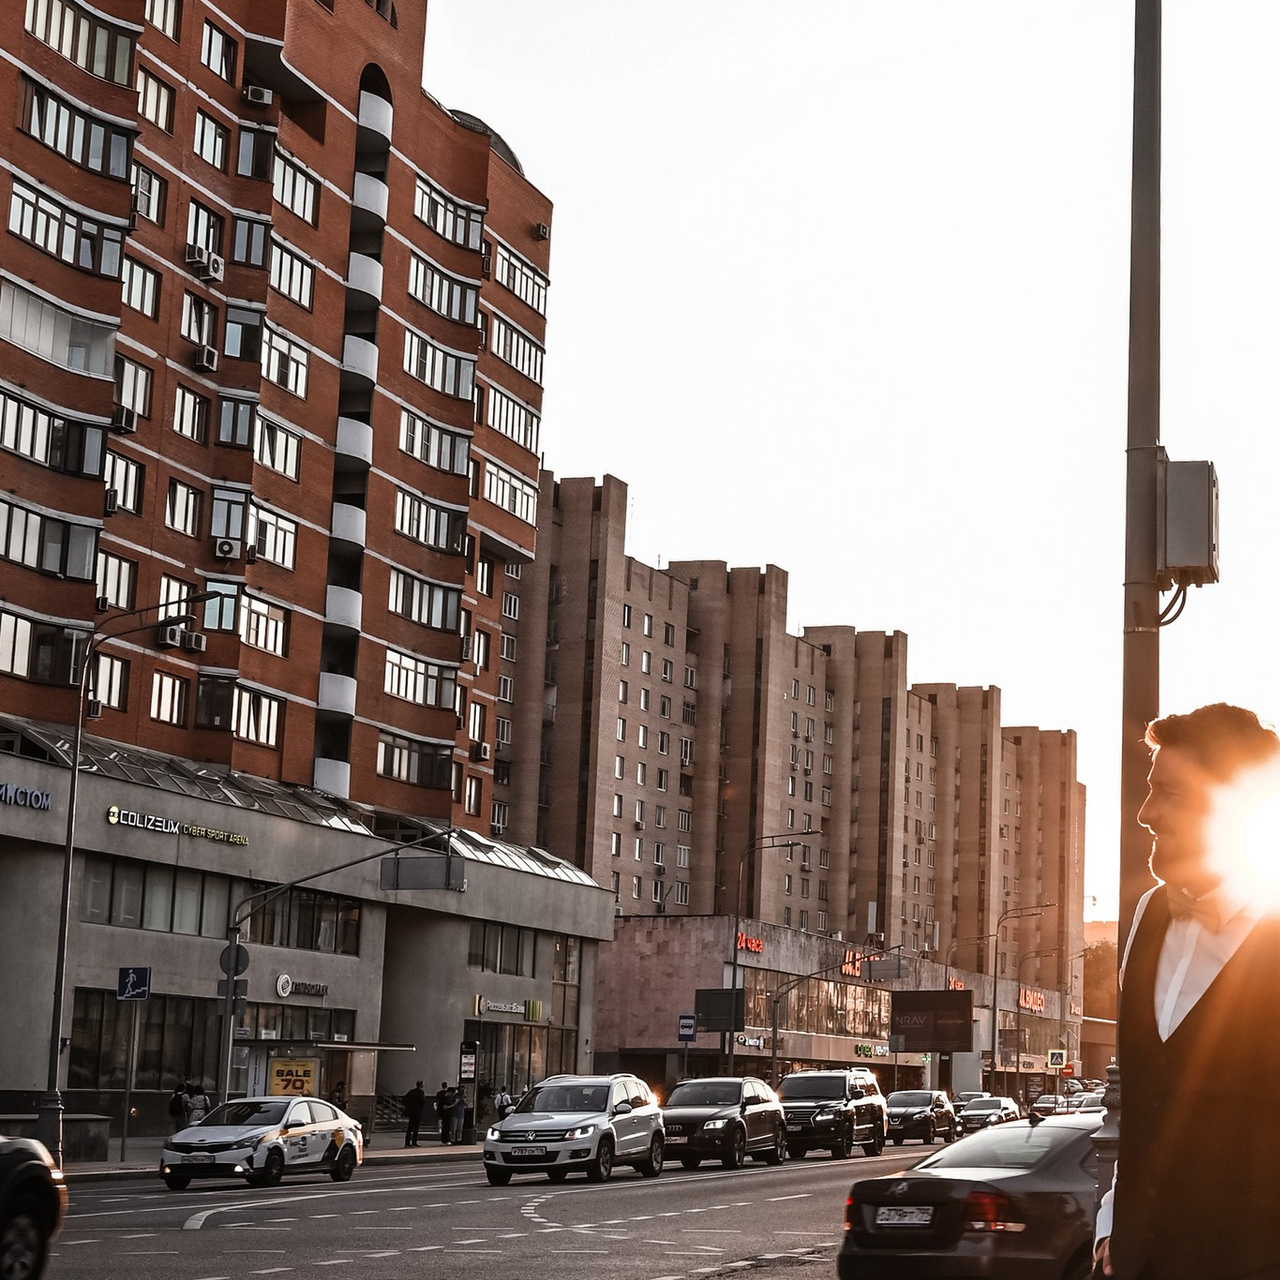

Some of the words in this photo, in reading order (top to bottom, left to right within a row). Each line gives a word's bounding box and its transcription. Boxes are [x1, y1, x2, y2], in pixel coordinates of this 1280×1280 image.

[119, 810, 180, 835] COLIZEUM
[183, 824, 206, 838] CYBER
[206, 828, 228, 842] SPORT
[229, 832, 249, 846] ARENA
[737, 932, 746, 950] 24
[747, 937, 763, 953] часа
[275, 1069, 312, 1078] SALE
